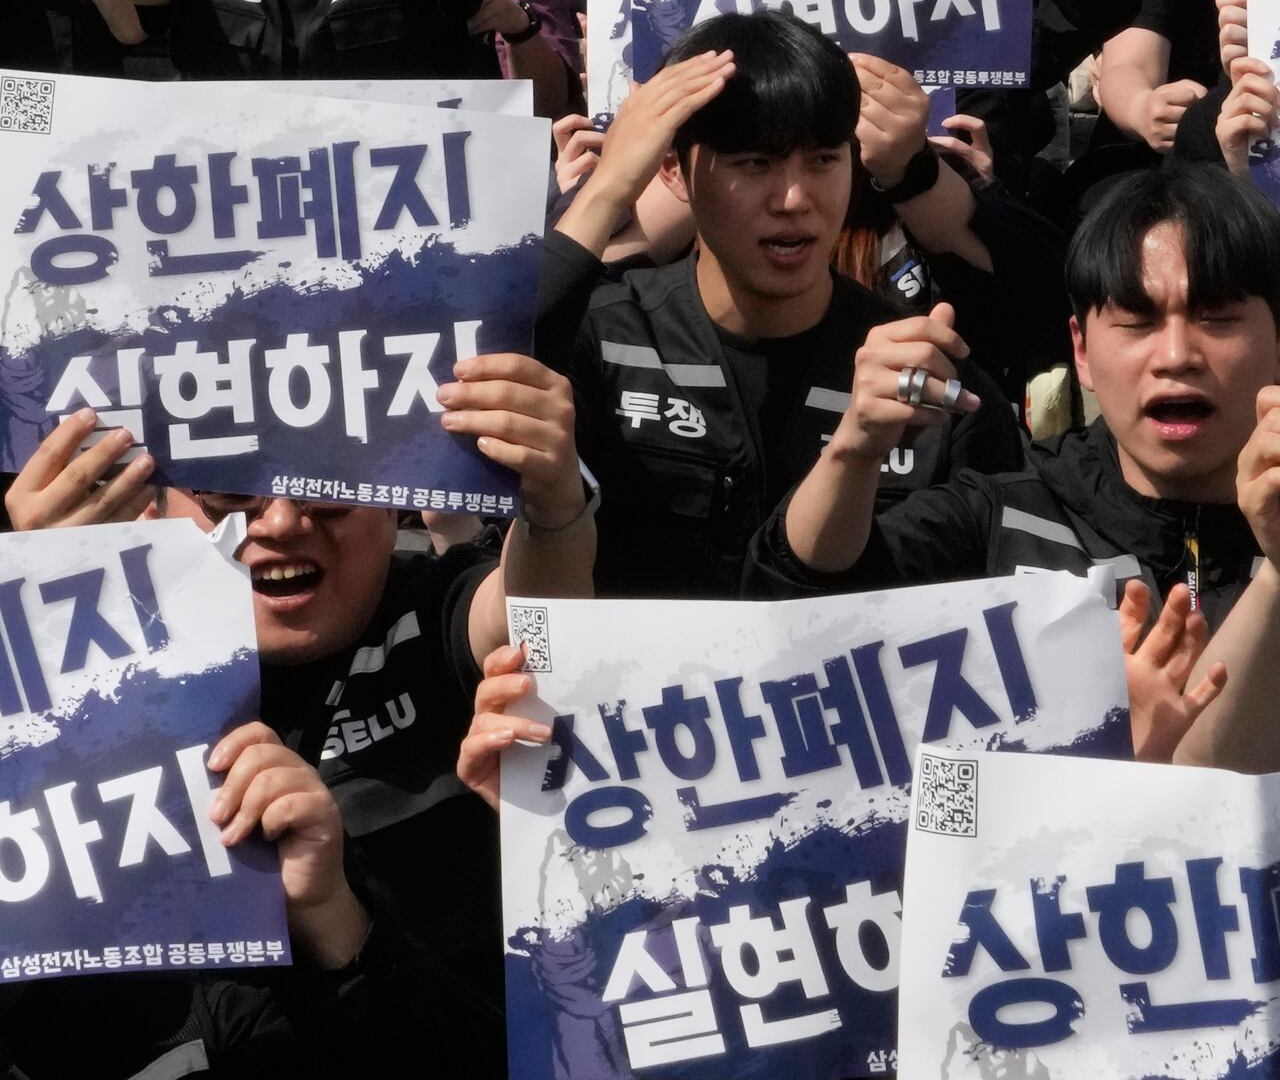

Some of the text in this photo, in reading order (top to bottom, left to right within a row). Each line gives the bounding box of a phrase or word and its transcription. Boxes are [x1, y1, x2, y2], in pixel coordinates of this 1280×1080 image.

[952, 69, 1026, 86] 공동투쟁본부
[14, 131, 473, 285] 상한폐지
[47, 321, 484, 461] 실현하자
[615, 390, 708, 440] 투쟁
[271, 474, 516, 514] 삼성전자노동조합 공동투쟁본부
[320, 693, 415, 763] SELU
[542, 600, 1037, 849] 상한폐지
[1, 939, 285, 977] 삼성전자노동조합 공동투쟁본부
[602, 881, 899, 1070] 실현
